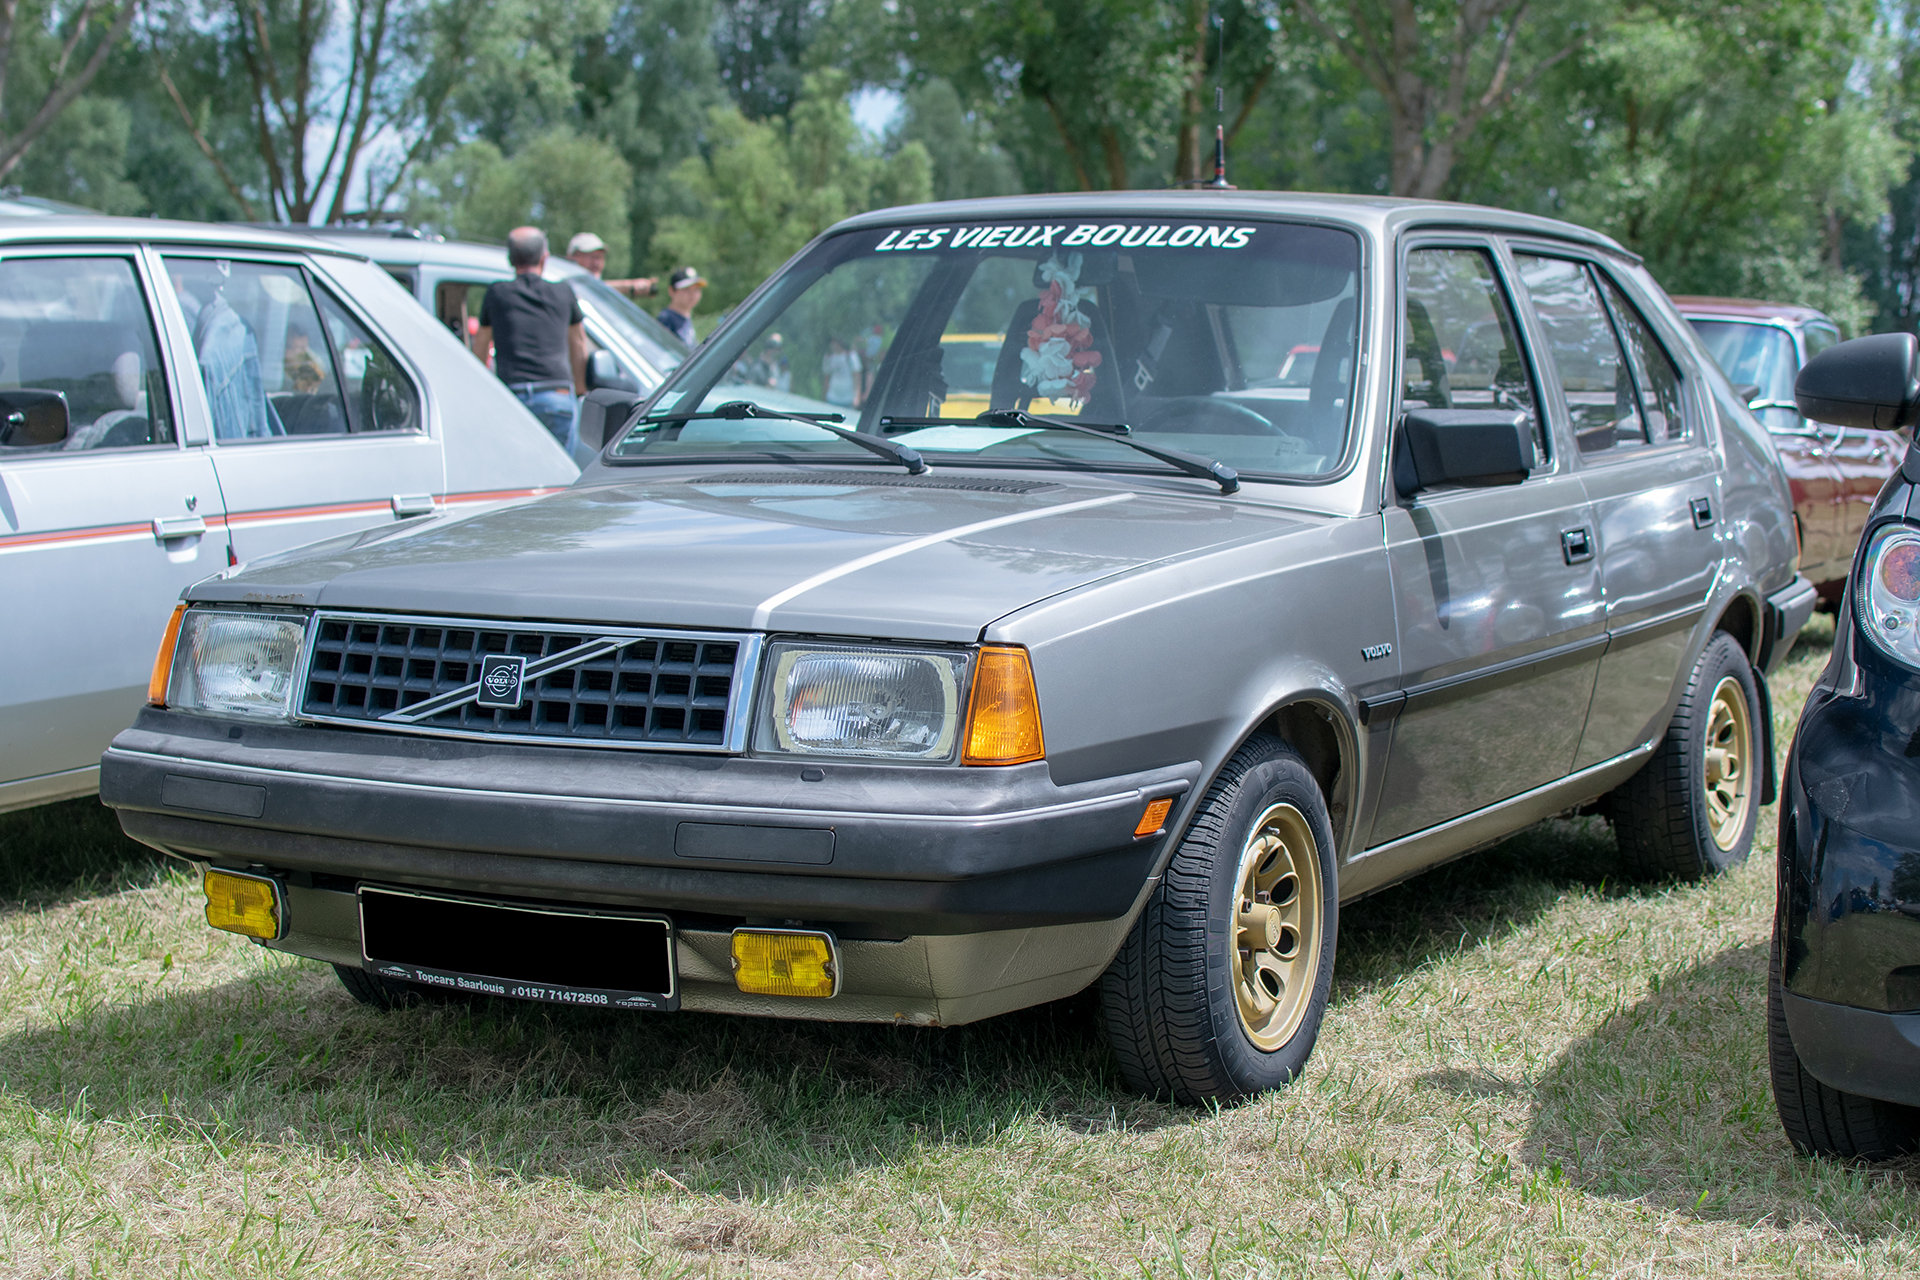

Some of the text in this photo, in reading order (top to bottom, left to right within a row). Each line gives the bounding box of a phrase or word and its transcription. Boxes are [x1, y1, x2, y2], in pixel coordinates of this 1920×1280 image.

[875, 224, 1256, 252] LES VIEUX BOULONS
[1361, 642, 1393, 659] VOLVO
[487, 677, 516, 685] VOLVO
[416, 970, 609, 1005] Topcars Saarlouis 0157 71472508
